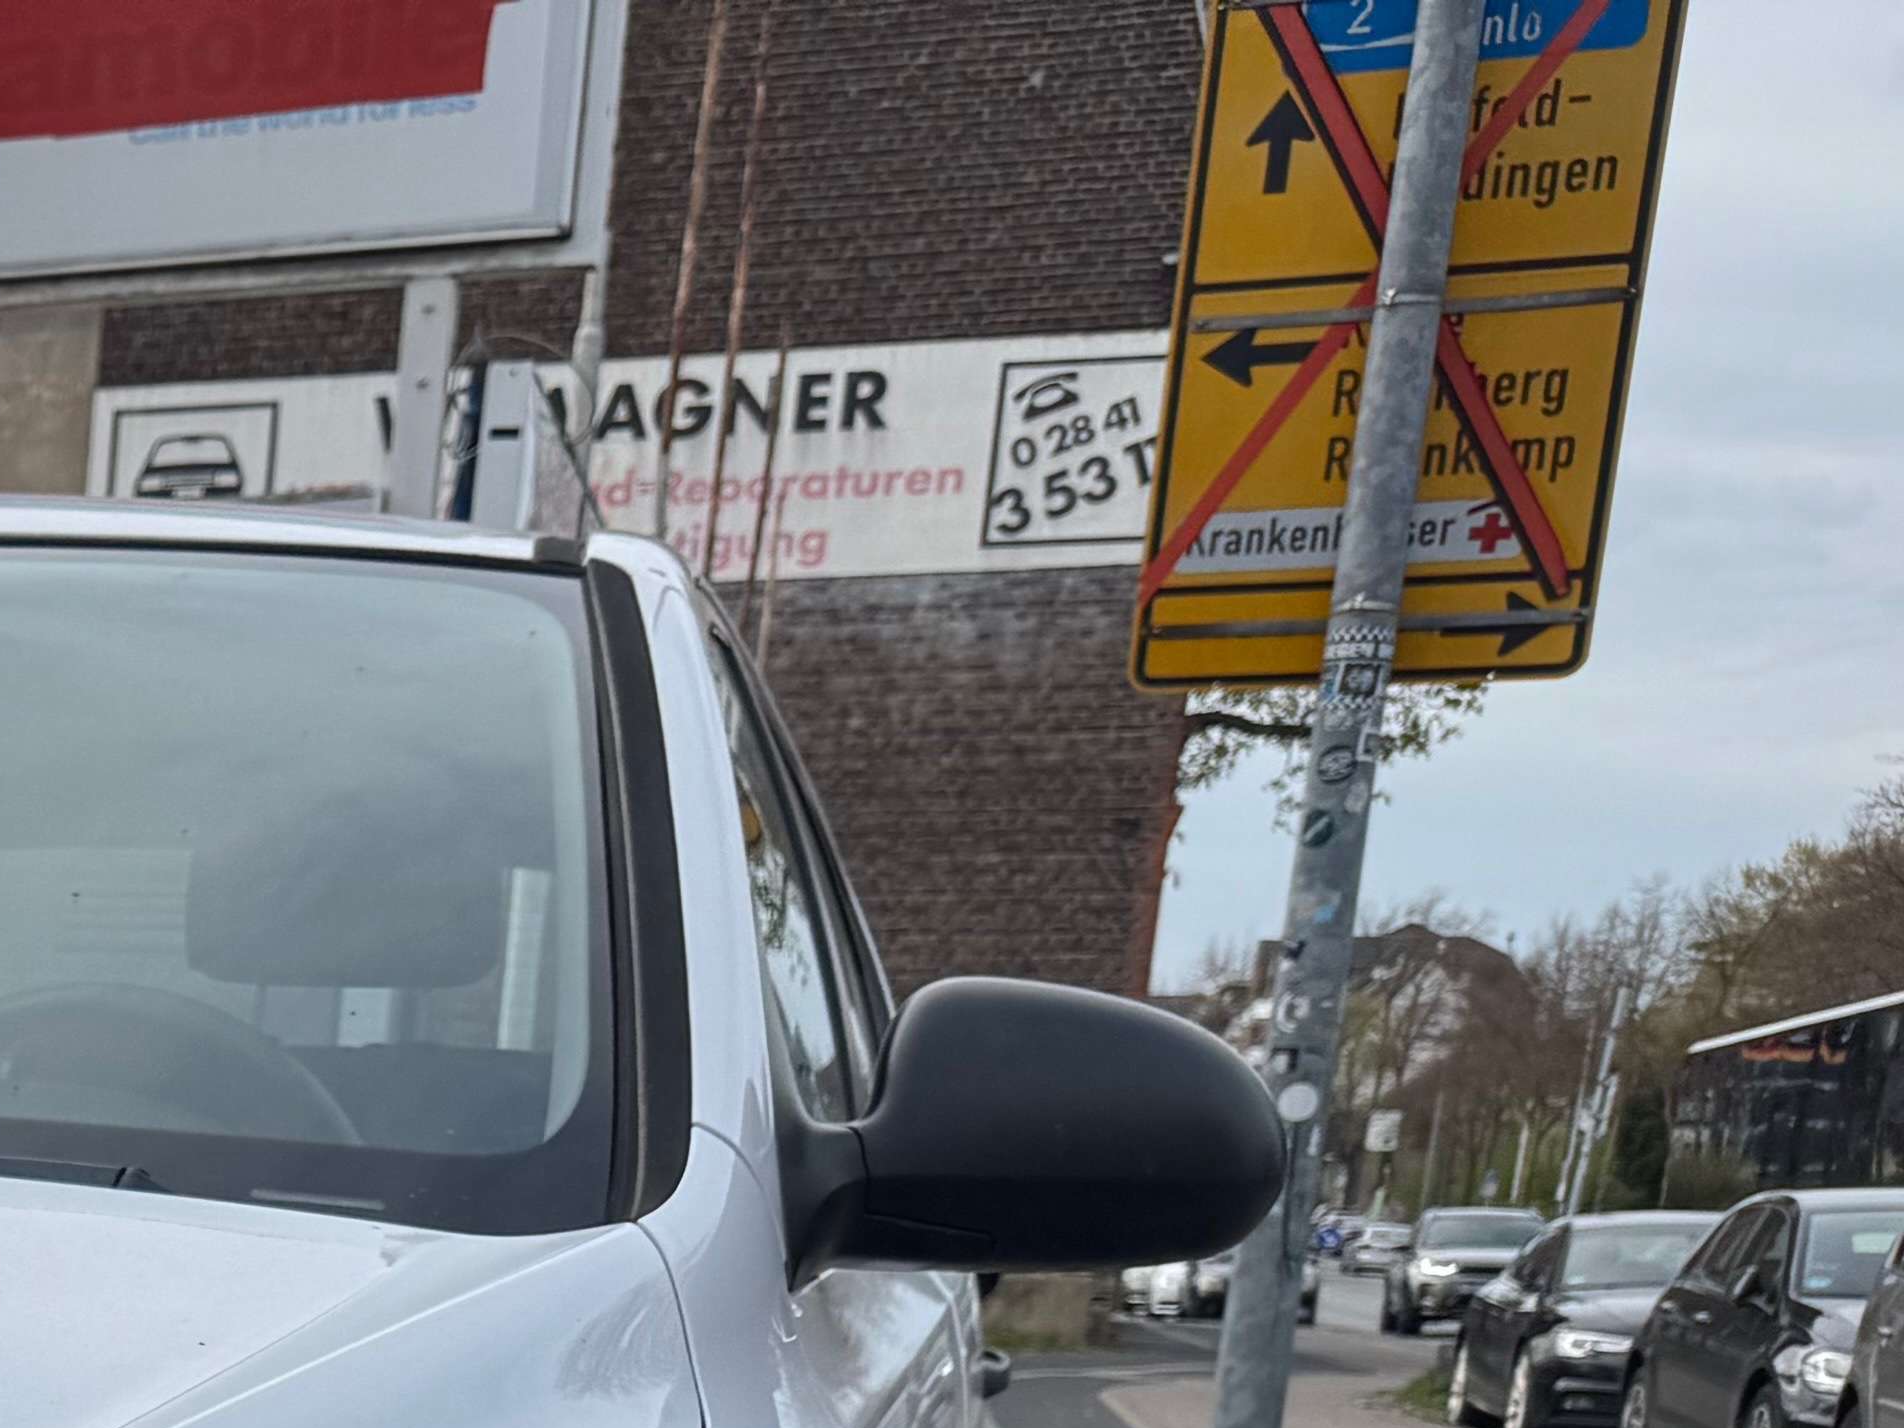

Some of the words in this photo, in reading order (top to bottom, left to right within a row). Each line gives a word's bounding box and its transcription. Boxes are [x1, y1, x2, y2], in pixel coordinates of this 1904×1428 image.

[1479, 3, 1542, 45] nlo
[544, 368, 889, 444] AGNER
[1011, 437, 1038, 469] 0
[1045, 415, 1096, 457] 28
[1101, 396, 1141, 432] 41
[991, 487, 1032, 534] 3
[1042, 456, 1118, 519] 53
